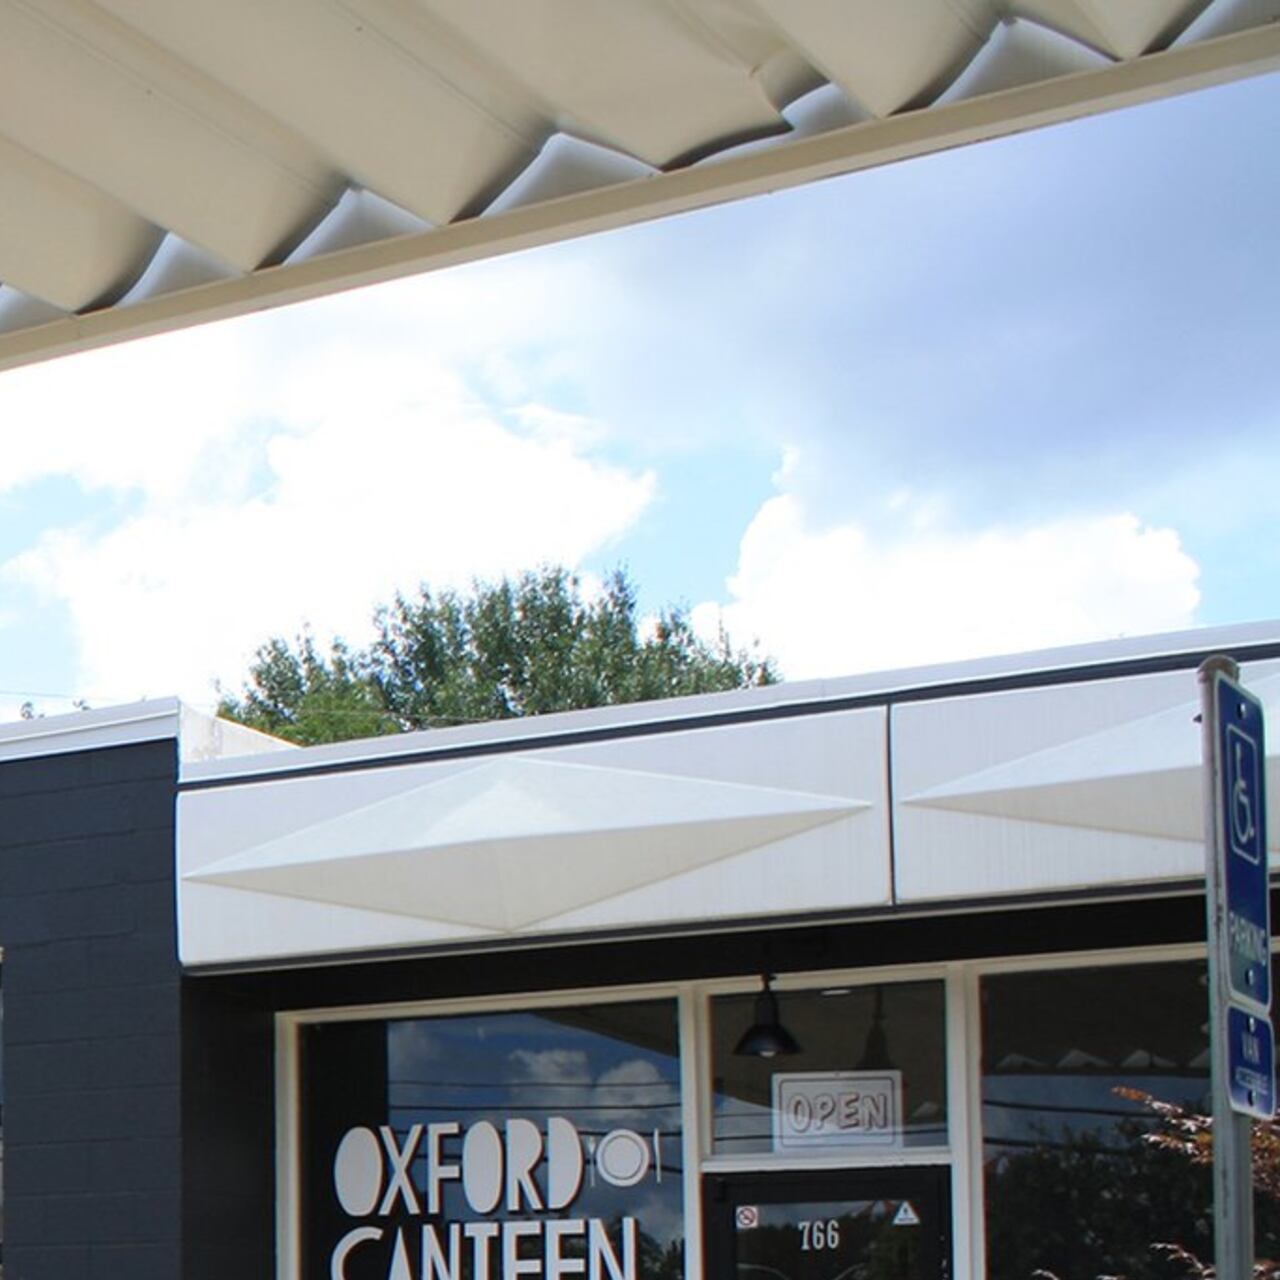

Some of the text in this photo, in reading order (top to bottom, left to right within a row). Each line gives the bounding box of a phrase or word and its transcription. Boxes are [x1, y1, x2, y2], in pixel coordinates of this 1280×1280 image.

[1228, 910, 1267, 967] PARKING
[789, 1092, 888, 1134] OPEN
[333, 1116, 584, 1217] OXFORD
[797, 1219, 840, 1251] 766
